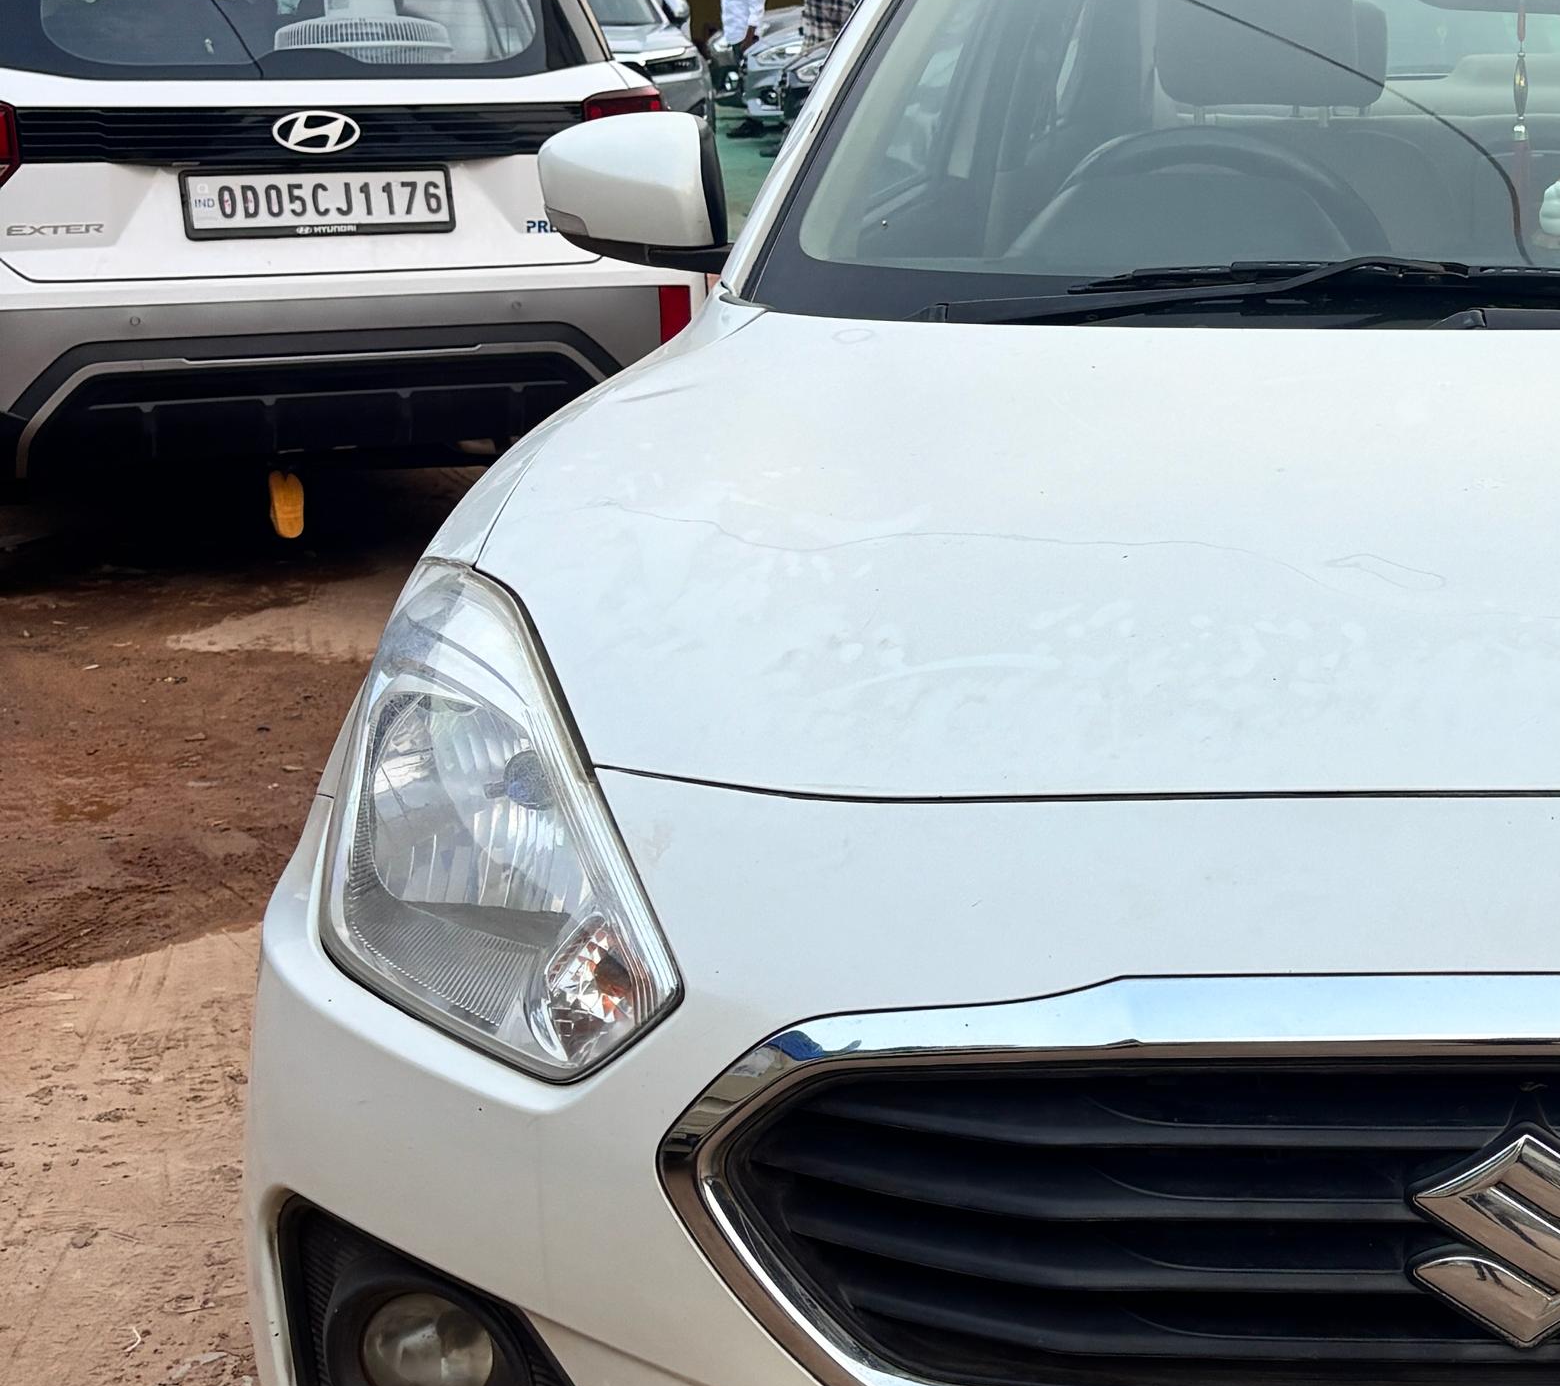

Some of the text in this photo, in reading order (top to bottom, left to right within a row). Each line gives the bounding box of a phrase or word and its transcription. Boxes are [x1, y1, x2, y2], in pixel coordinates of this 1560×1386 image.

[194, 180, 443, 219] IND OD05CJ1176
[6, 223, 105, 237] EXTER
[313, 224, 358, 234] HYUNDAI
